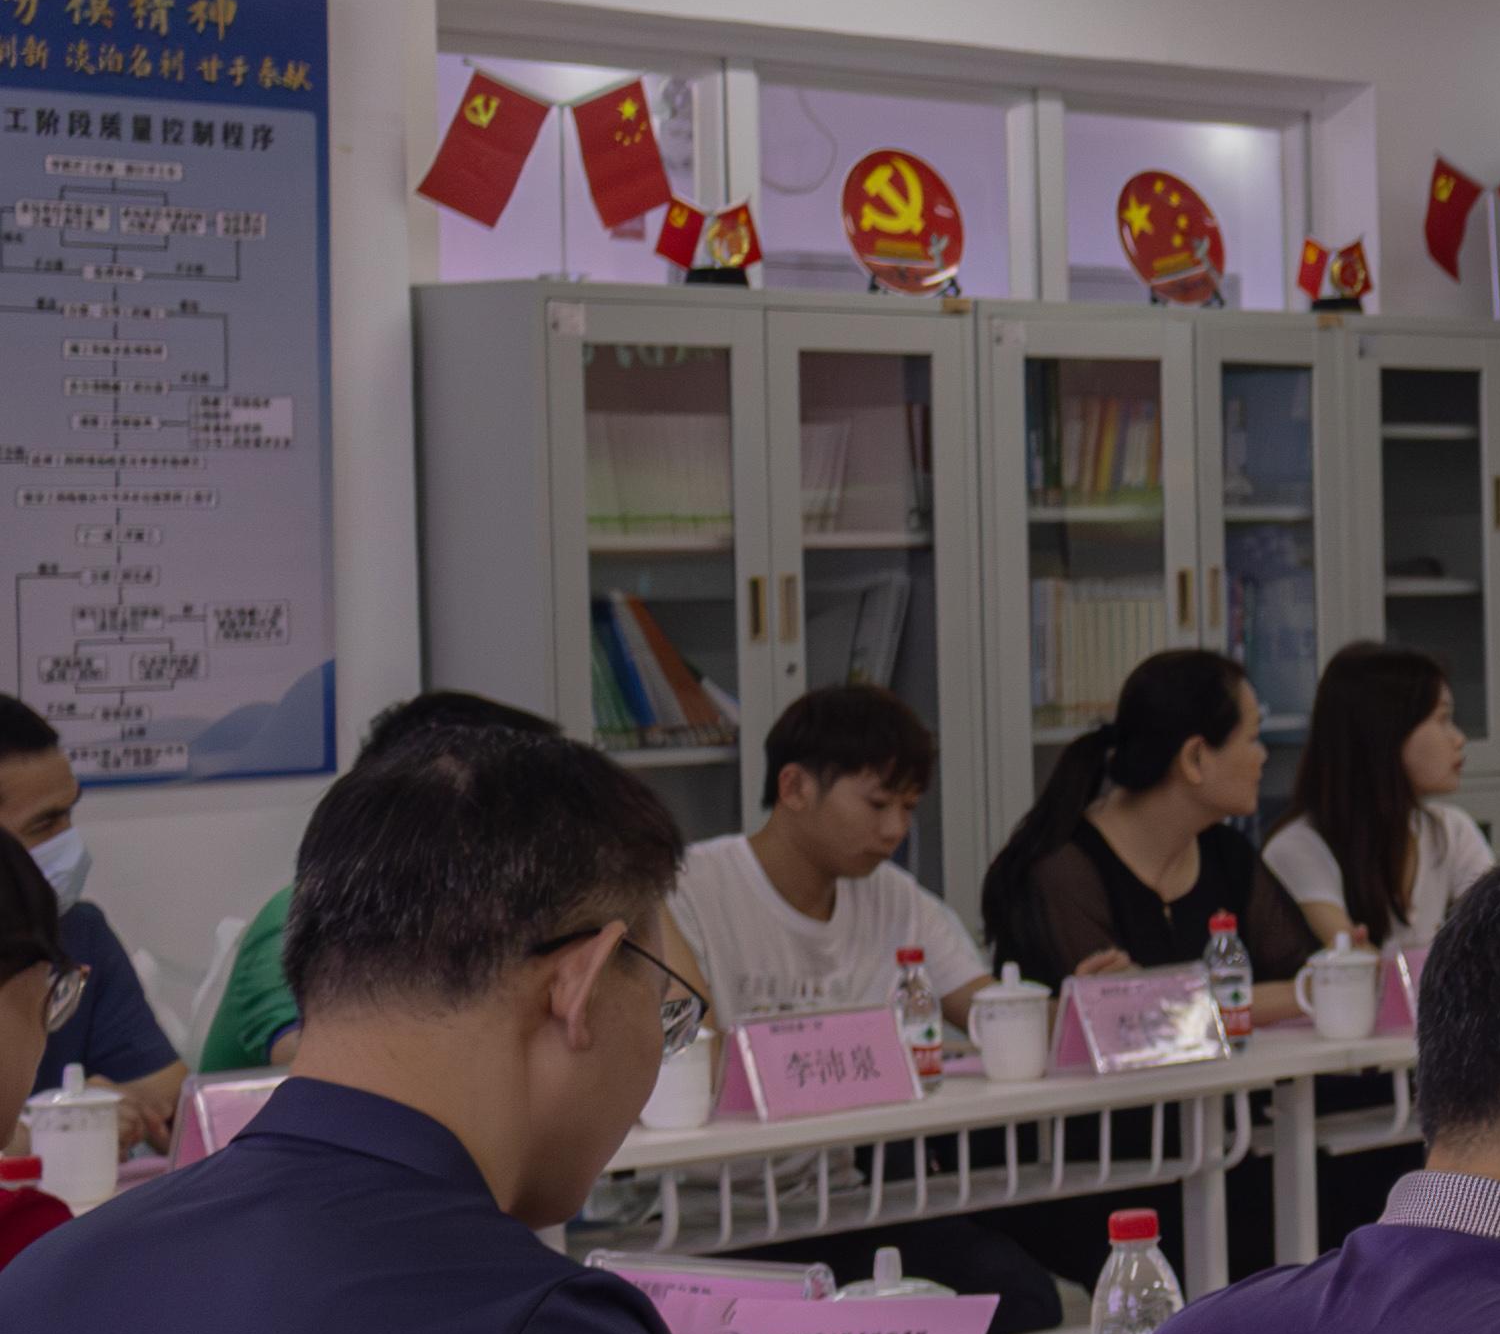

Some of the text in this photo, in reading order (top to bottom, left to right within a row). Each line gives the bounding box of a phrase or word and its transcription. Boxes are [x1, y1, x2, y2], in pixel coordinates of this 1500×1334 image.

[4, 107, 274, 152] 工阶段质量控制程序
